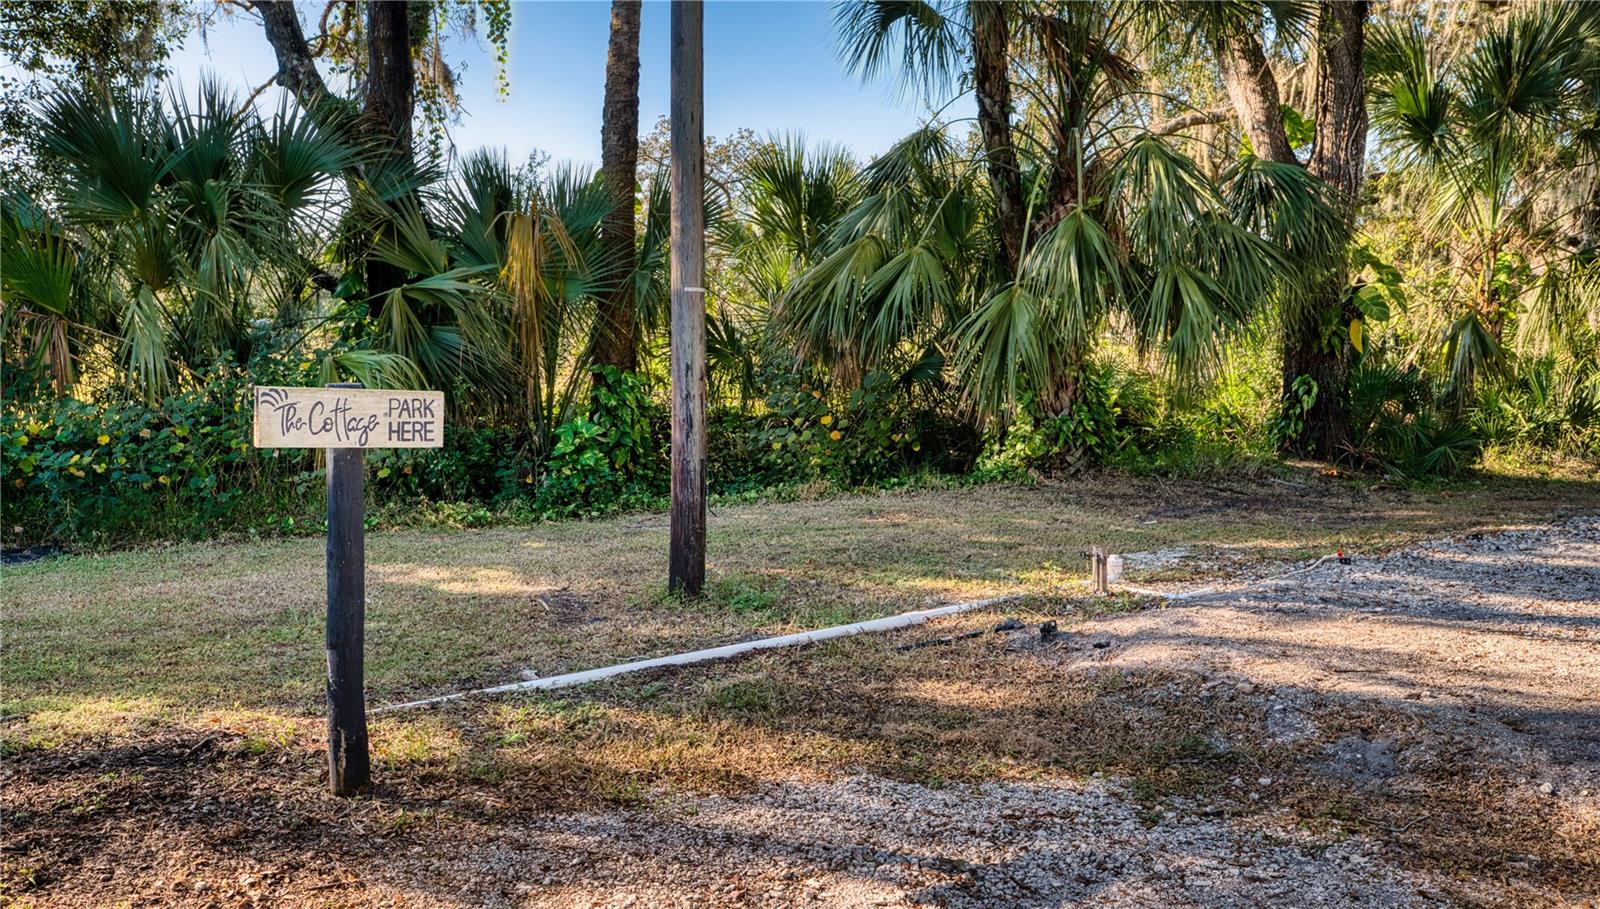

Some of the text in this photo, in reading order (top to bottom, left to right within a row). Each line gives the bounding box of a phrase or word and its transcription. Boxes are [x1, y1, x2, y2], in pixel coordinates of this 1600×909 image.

[388, 398, 435, 418] PARK
[273, 397, 379, 446] The Cottage
[388, 421, 435, 441] HERE
